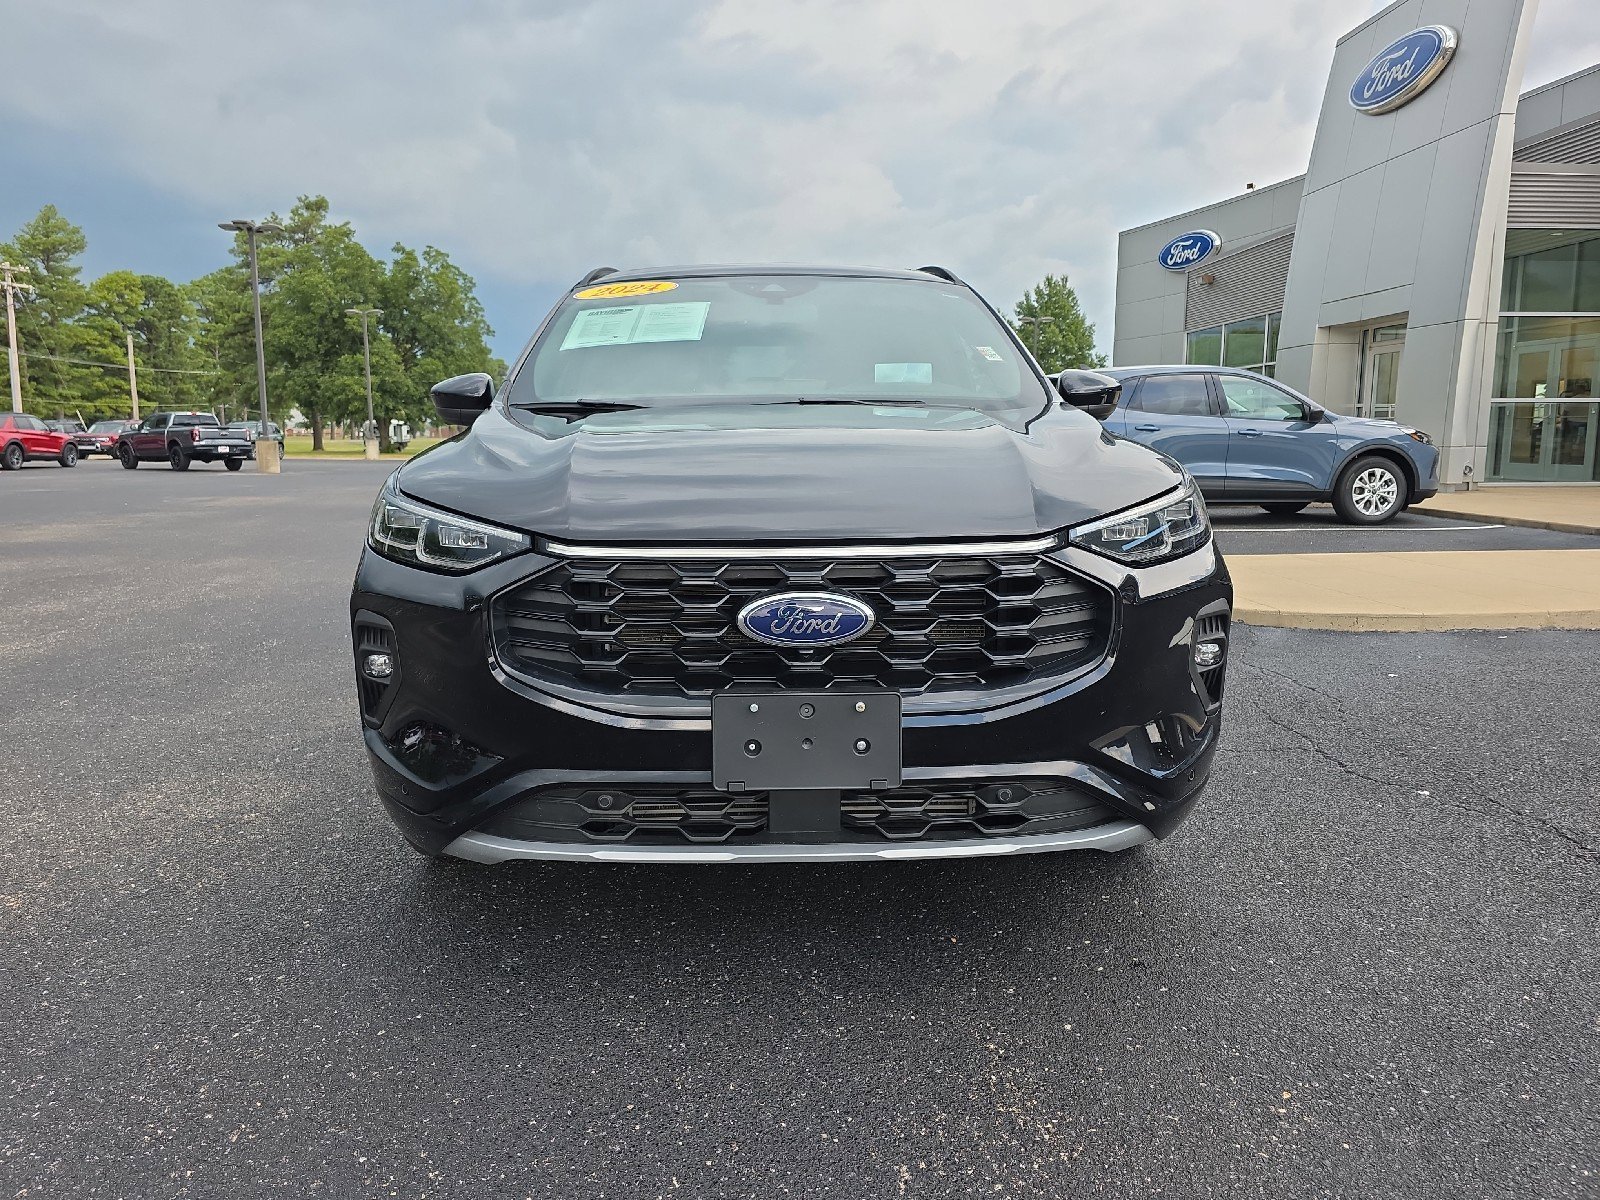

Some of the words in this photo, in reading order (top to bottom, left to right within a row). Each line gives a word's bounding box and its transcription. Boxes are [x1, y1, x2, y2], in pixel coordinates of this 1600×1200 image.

[1364, 47, 1420, 99] Ford
[1167, 239, 1201, 265] Ford
[592, 283, 661, 297] 2024
[771, 604, 842, 634] Ford
